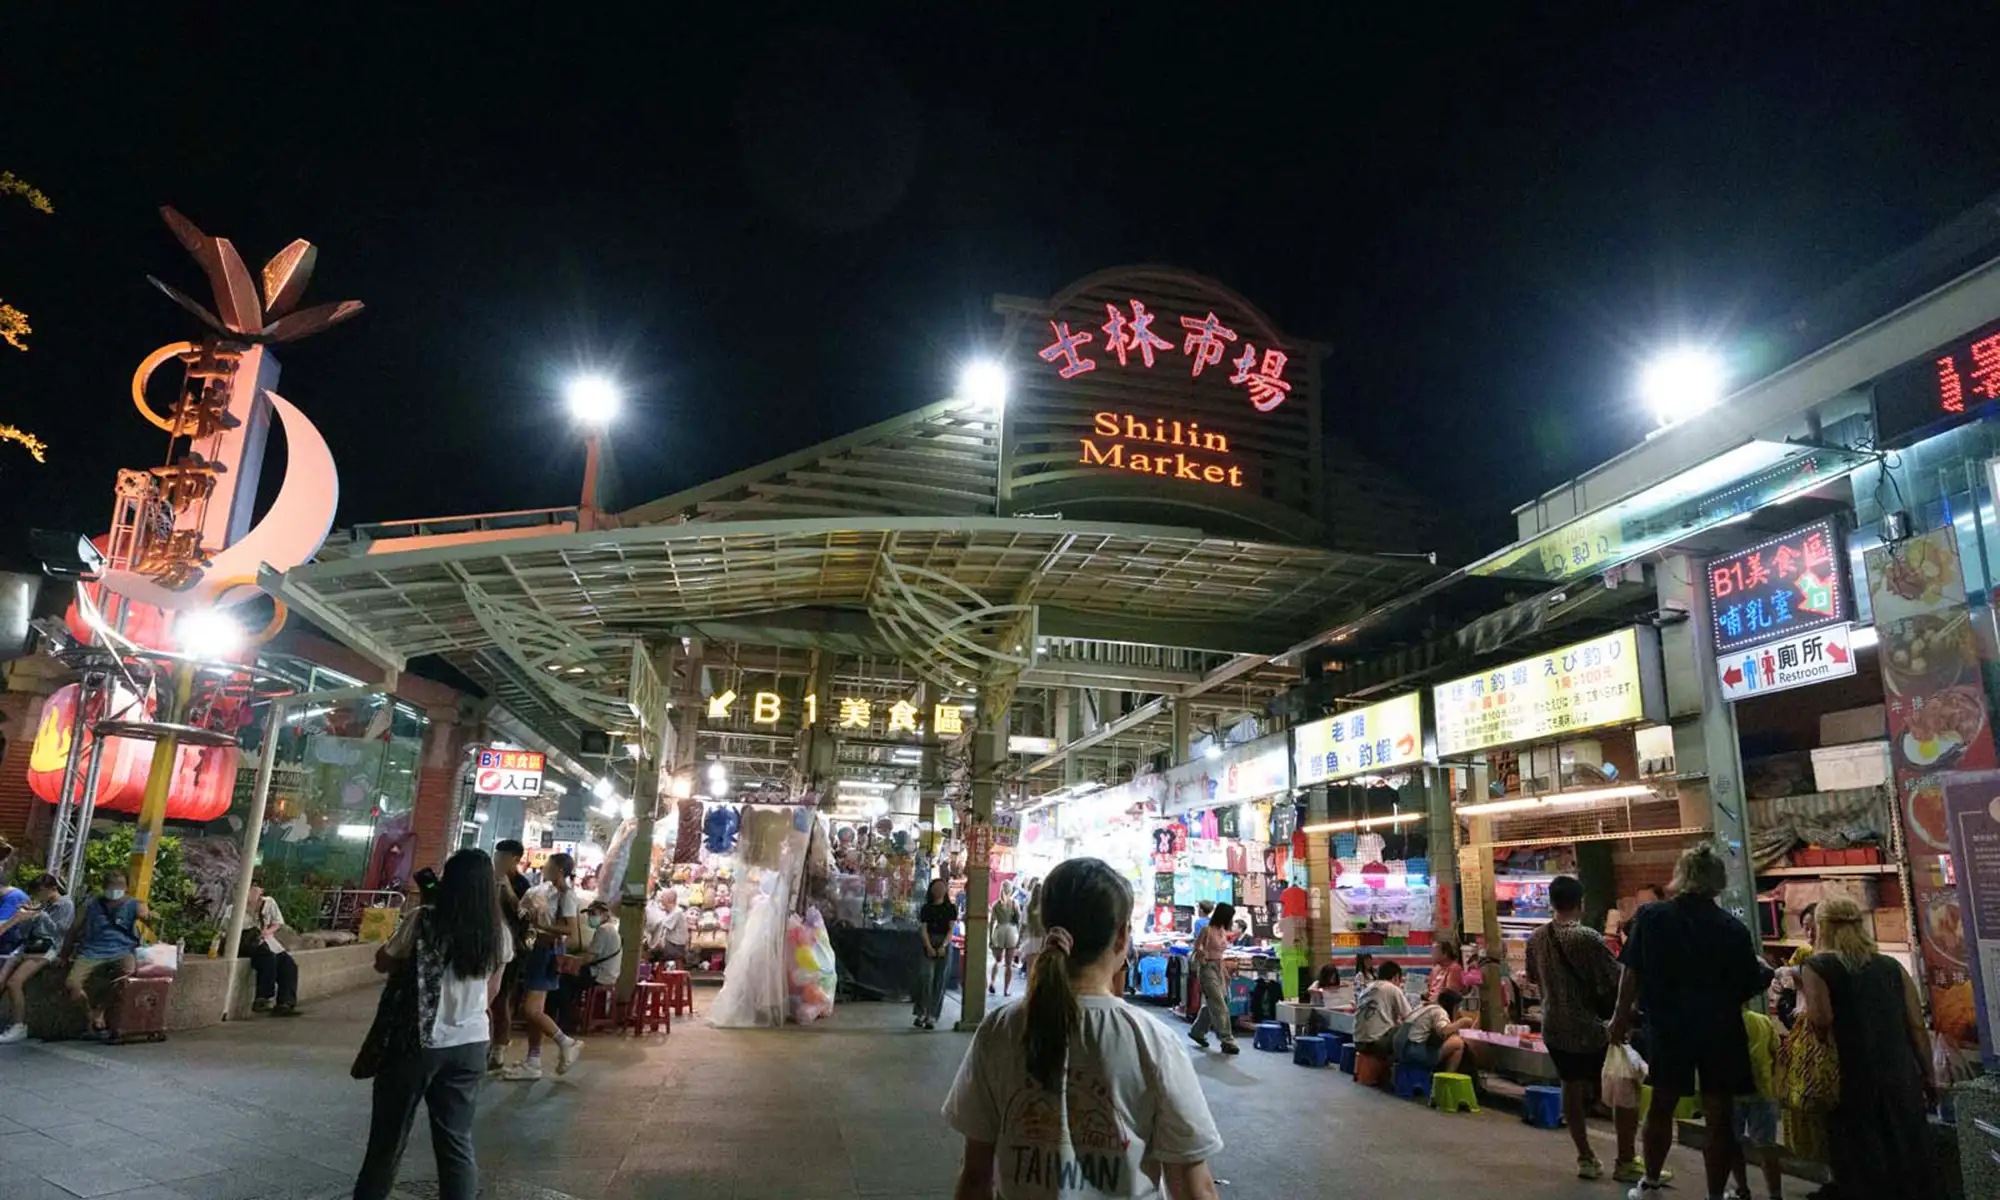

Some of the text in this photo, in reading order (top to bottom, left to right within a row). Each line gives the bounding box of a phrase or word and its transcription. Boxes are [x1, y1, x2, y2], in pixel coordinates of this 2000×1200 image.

[1038, 299, 1292, 412] 士林市場
[1093, 411, 1230, 454] Shilin
[1079, 438, 1244, 488] Market
[1713, 532, 1831, 598] B1美食區
[1719, 588, 1794, 637] 哺乳室
[1777, 636, 1823, 670] 廁所
[1778, 663, 1830, 684] Restroom
[752, 692, 963, 735] B1美食區
[503, 774, 539, 791] 入口
[1010, 1144, 1120, 1192] TAIWAN
